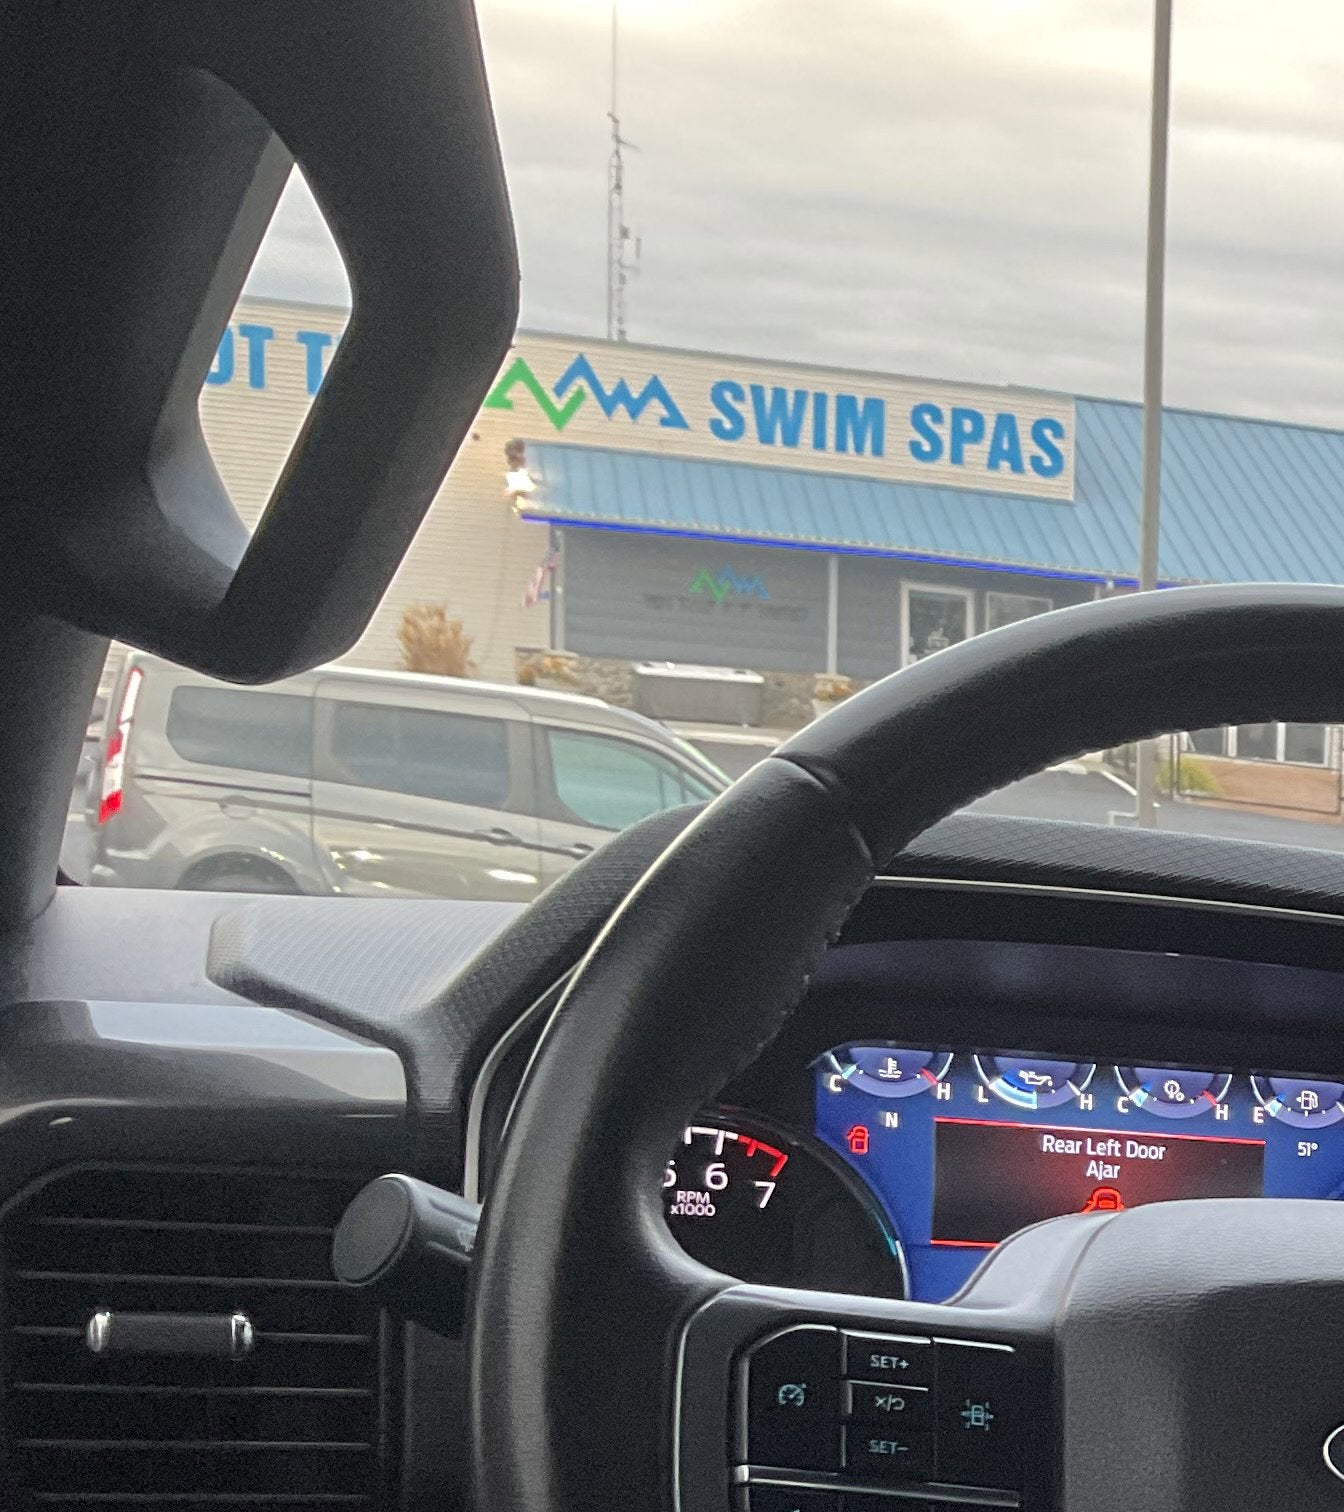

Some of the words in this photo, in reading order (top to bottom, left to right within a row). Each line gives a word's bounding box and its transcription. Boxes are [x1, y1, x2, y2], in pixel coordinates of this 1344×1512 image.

[205, 322, 275, 390] OT
[708, 379, 886, 458] SWIM
[908, 403, 1065, 479] SPAS
[829, 1074, 842, 1092] C
[937, 1082, 950, 1100] H
[978, 1086, 989, 1103] L
[1080, 1093, 1093, 1111] H
[1117, 1096, 1129, 1114] C
[1215, 1104, 1229, 1121] H
[884, 1112, 899, 1128] N
[1253, 1106, 1265, 1124] E
[1042, 1134, 1082, 1154] Rear
[1086, 1137, 1121, 1157] Left
[1125, 1140, 1166, 1160] Door
[1086, 1161, 1120, 1180] Ajar
[705, 1162, 729, 1191] 6
[754, 1180, 776, 1209] 7
[676, 1190, 711, 1204] RPM
[670, 1203, 716, 1217] x1000
[870, 1354, 909, 1369] SET+
